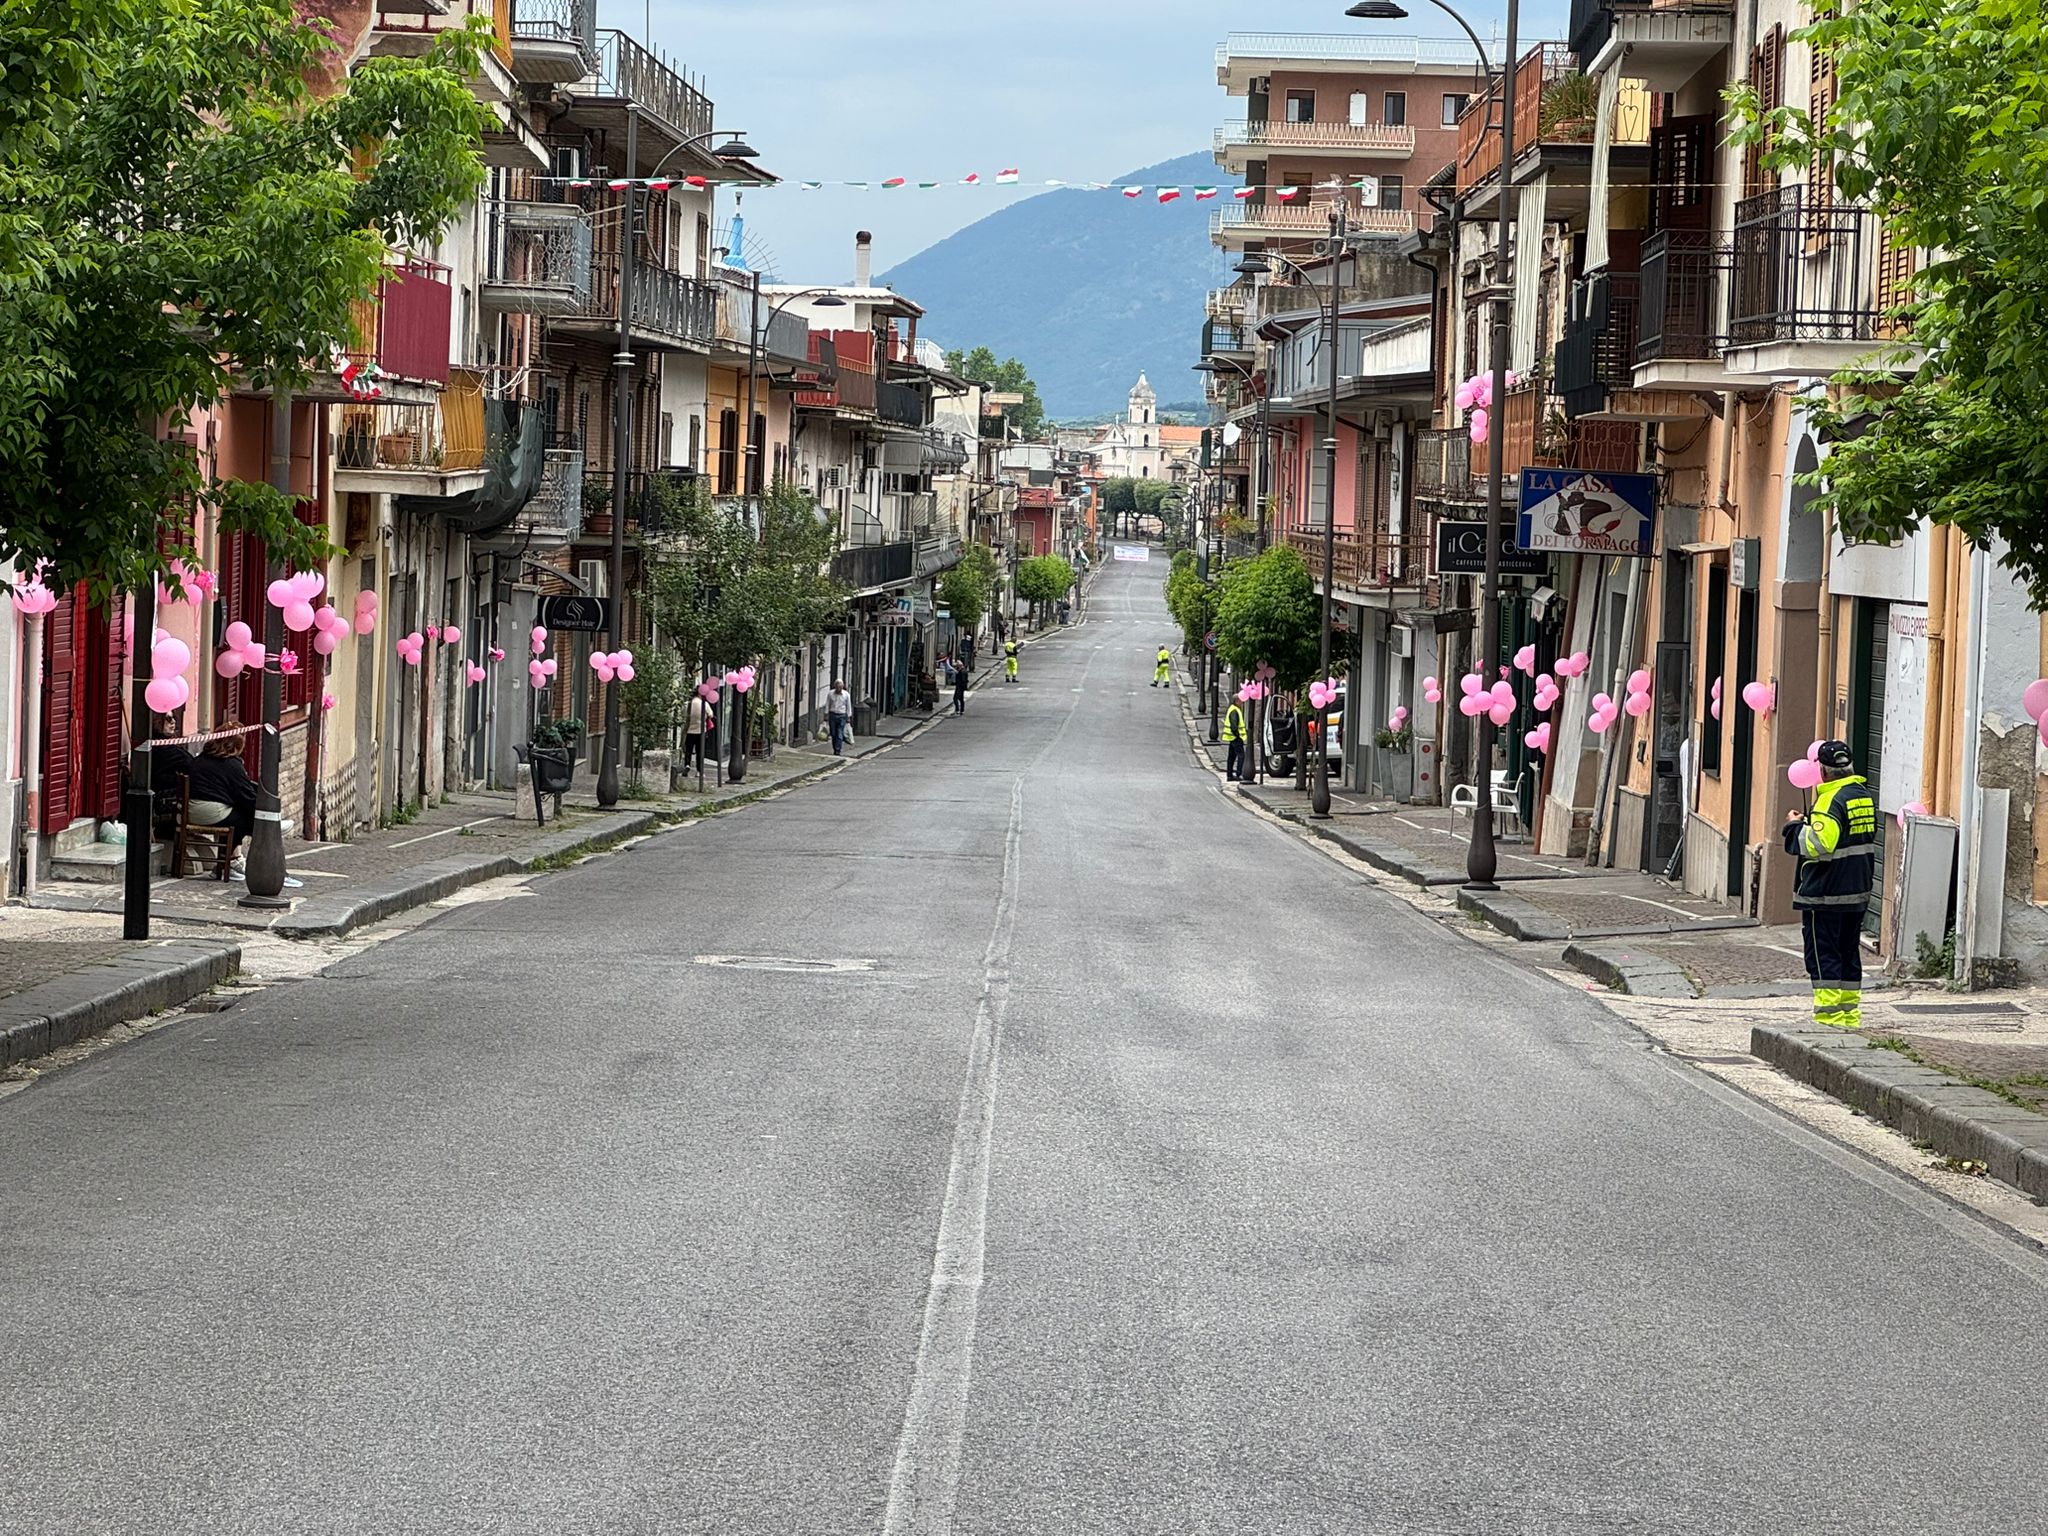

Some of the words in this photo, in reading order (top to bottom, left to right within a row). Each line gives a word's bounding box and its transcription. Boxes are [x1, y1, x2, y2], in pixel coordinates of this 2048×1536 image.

[1528, 473, 1556, 490] LA
[1562, 474, 1615, 493] CASA
[1448, 537, 1456, 553] il
[1533, 534, 1557, 547] DEI
